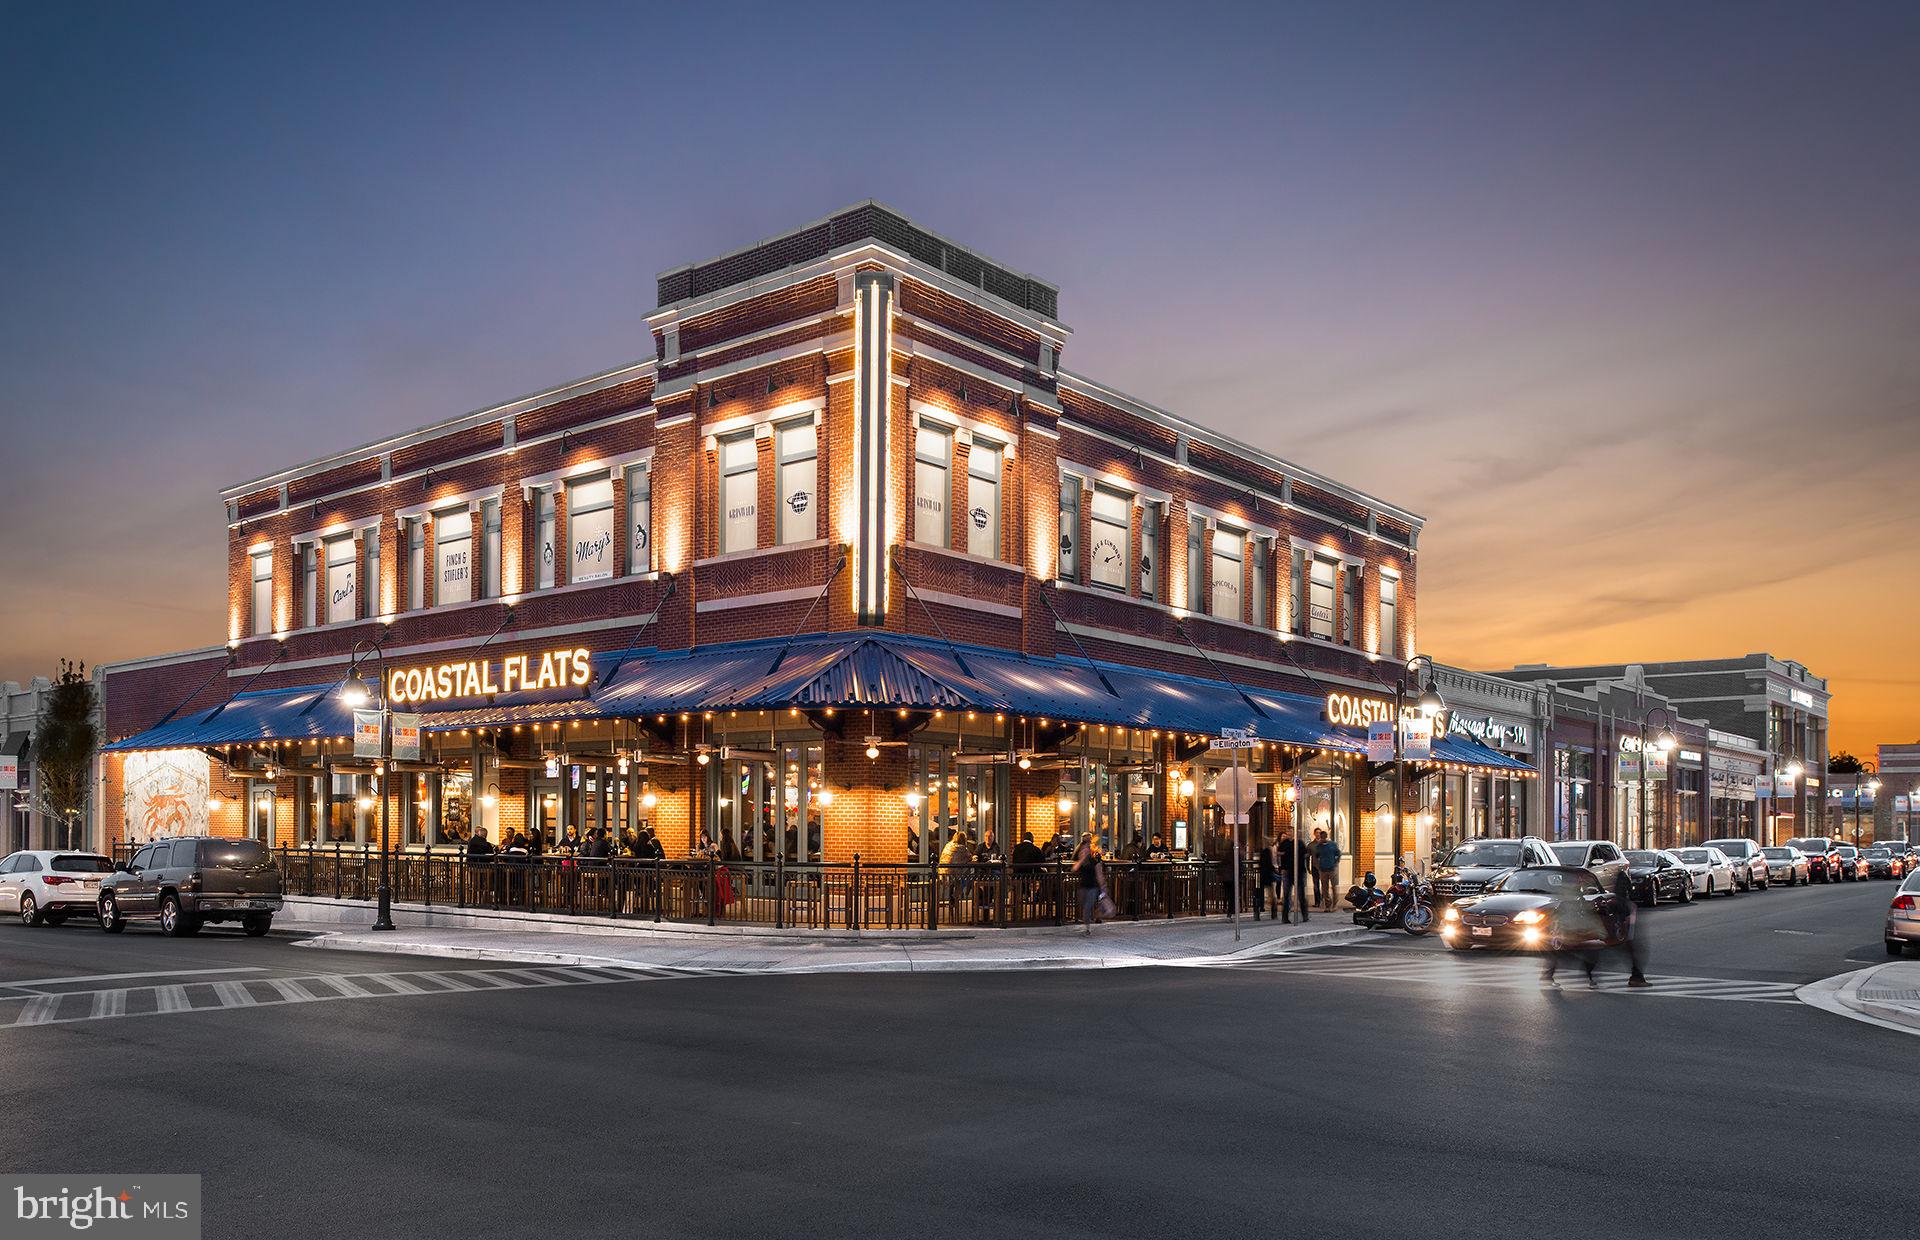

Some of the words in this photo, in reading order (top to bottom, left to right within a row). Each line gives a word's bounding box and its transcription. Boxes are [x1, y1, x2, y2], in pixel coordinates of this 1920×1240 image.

[575, 532, 611, 562] Mary's
[446, 553, 462, 567] FINCH
[443, 567, 469, 582] STIFLER'S
[390, 660, 498, 703] COASTAL
[503, 648, 591, 692] FLATS
[1447, 710, 1486, 740] Massage
[1513, 725, 1528, 745] SPA
[1219, 740, 1251, 748] Ellington
